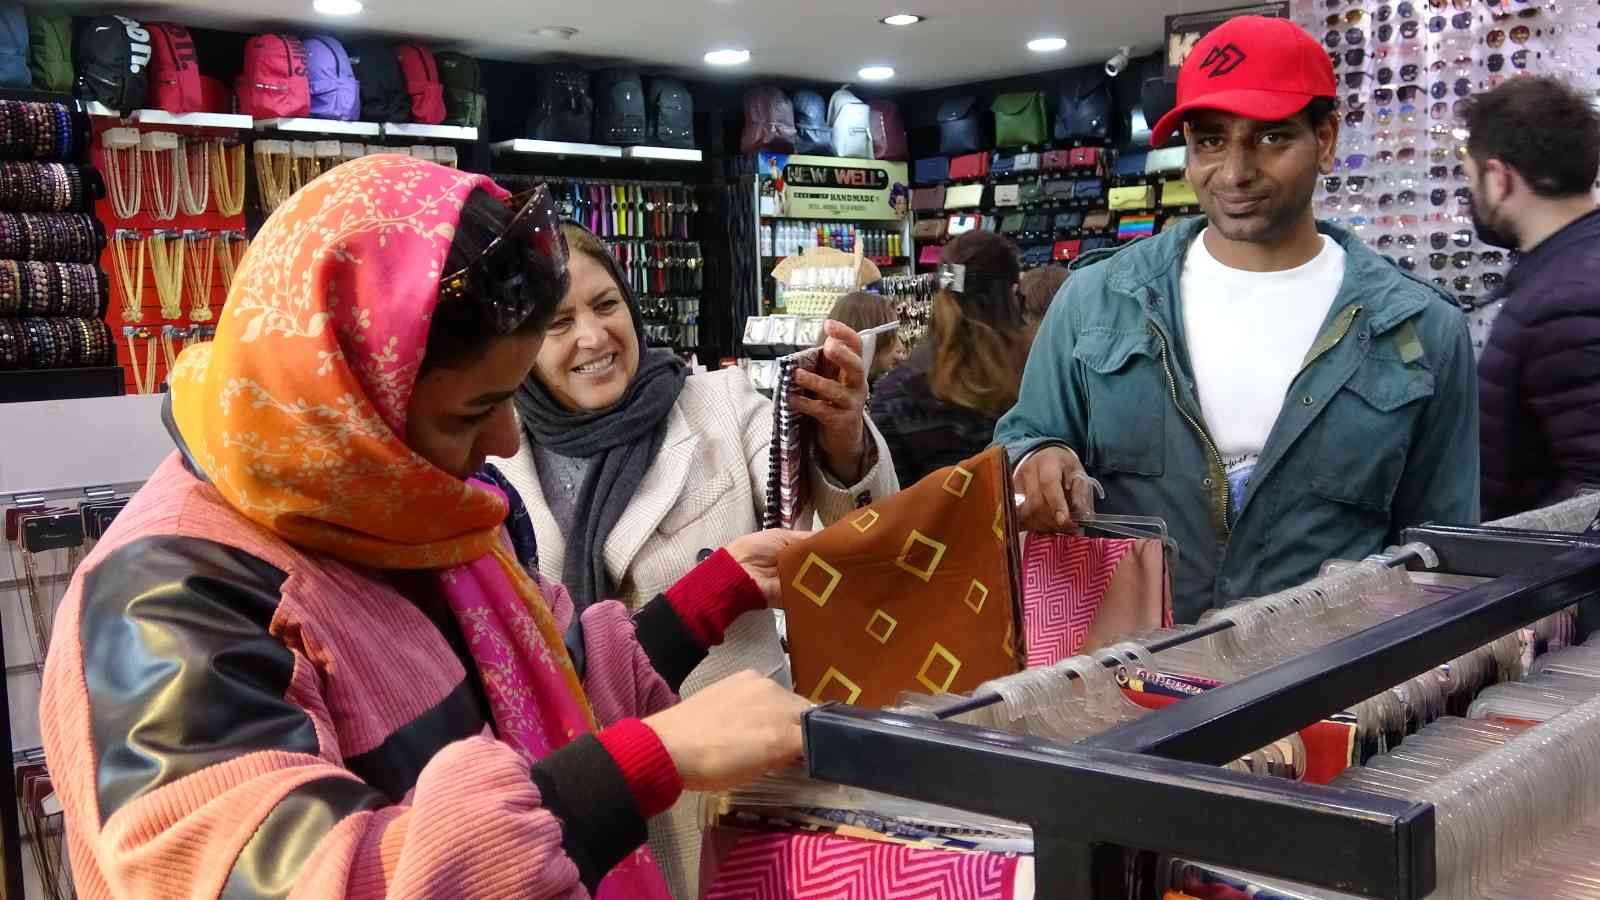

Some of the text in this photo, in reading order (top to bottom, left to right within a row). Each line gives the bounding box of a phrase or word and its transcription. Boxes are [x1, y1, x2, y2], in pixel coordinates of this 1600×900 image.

[787, 166, 881, 186] NEW WELL
[830, 193, 875, 203] HANDMADE
